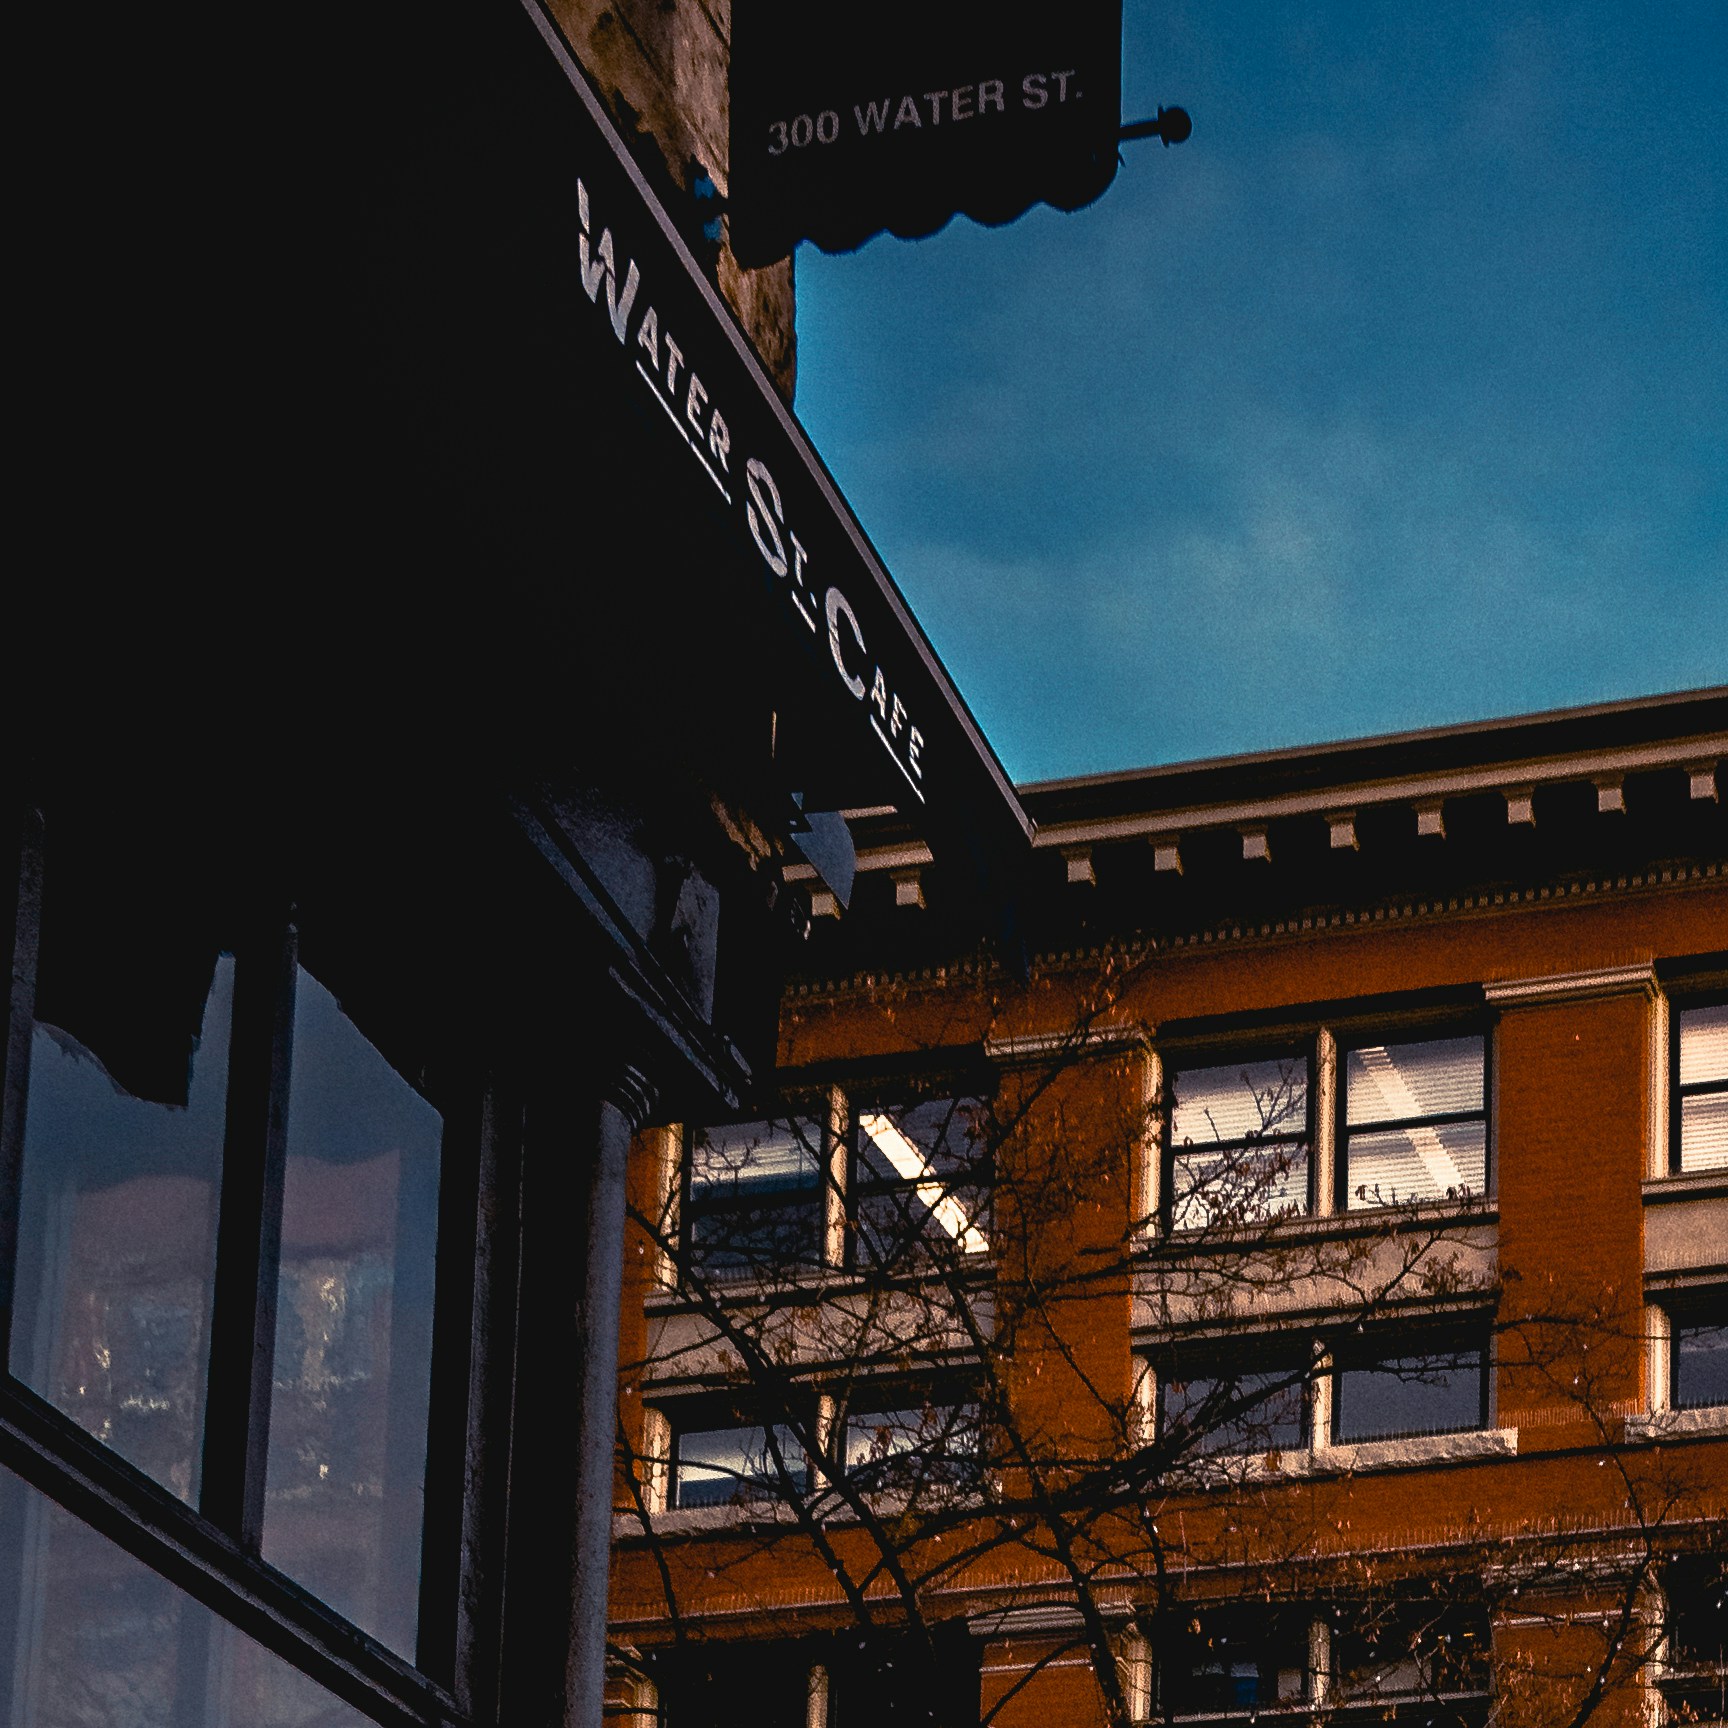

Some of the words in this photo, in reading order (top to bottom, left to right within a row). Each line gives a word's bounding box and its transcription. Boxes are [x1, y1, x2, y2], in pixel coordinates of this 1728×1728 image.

[768, 110, 839, 155] 300
[853, 78, 1005, 136] WATER
[1022, 69, 1083, 110] ST.
